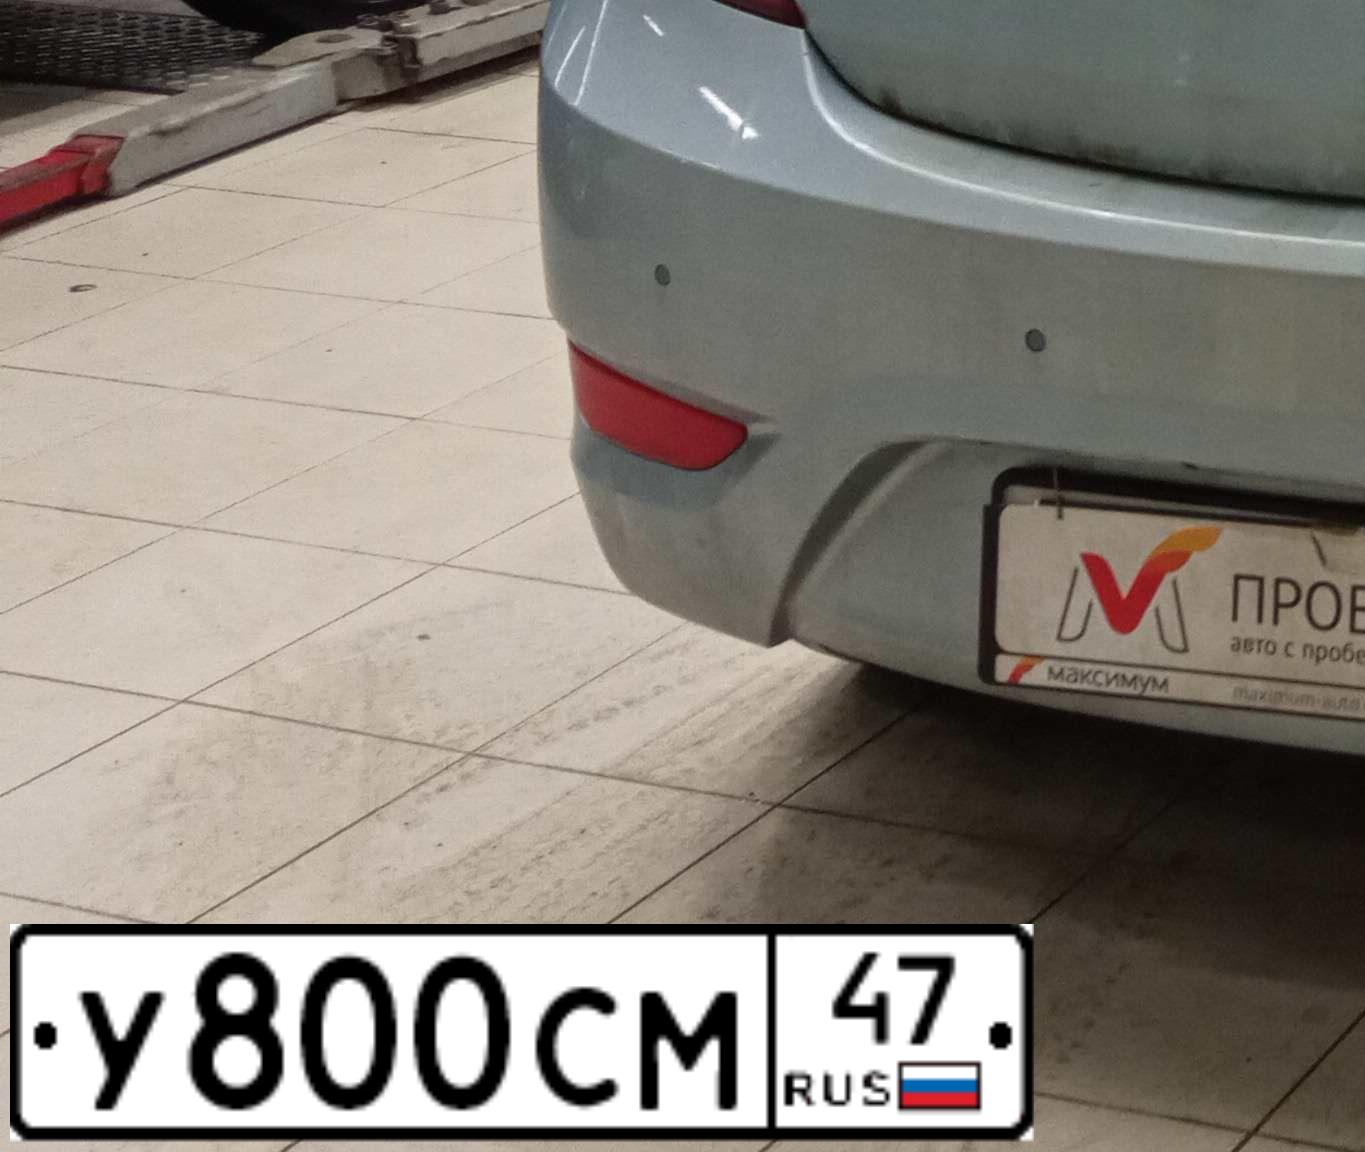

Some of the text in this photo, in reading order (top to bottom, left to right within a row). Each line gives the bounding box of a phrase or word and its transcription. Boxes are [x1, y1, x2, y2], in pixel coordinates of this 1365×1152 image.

[1230, 635, 1278, 656] авто
[1283, 640, 1295, 658] с
[1047, 666, 1170, 696] максимум
